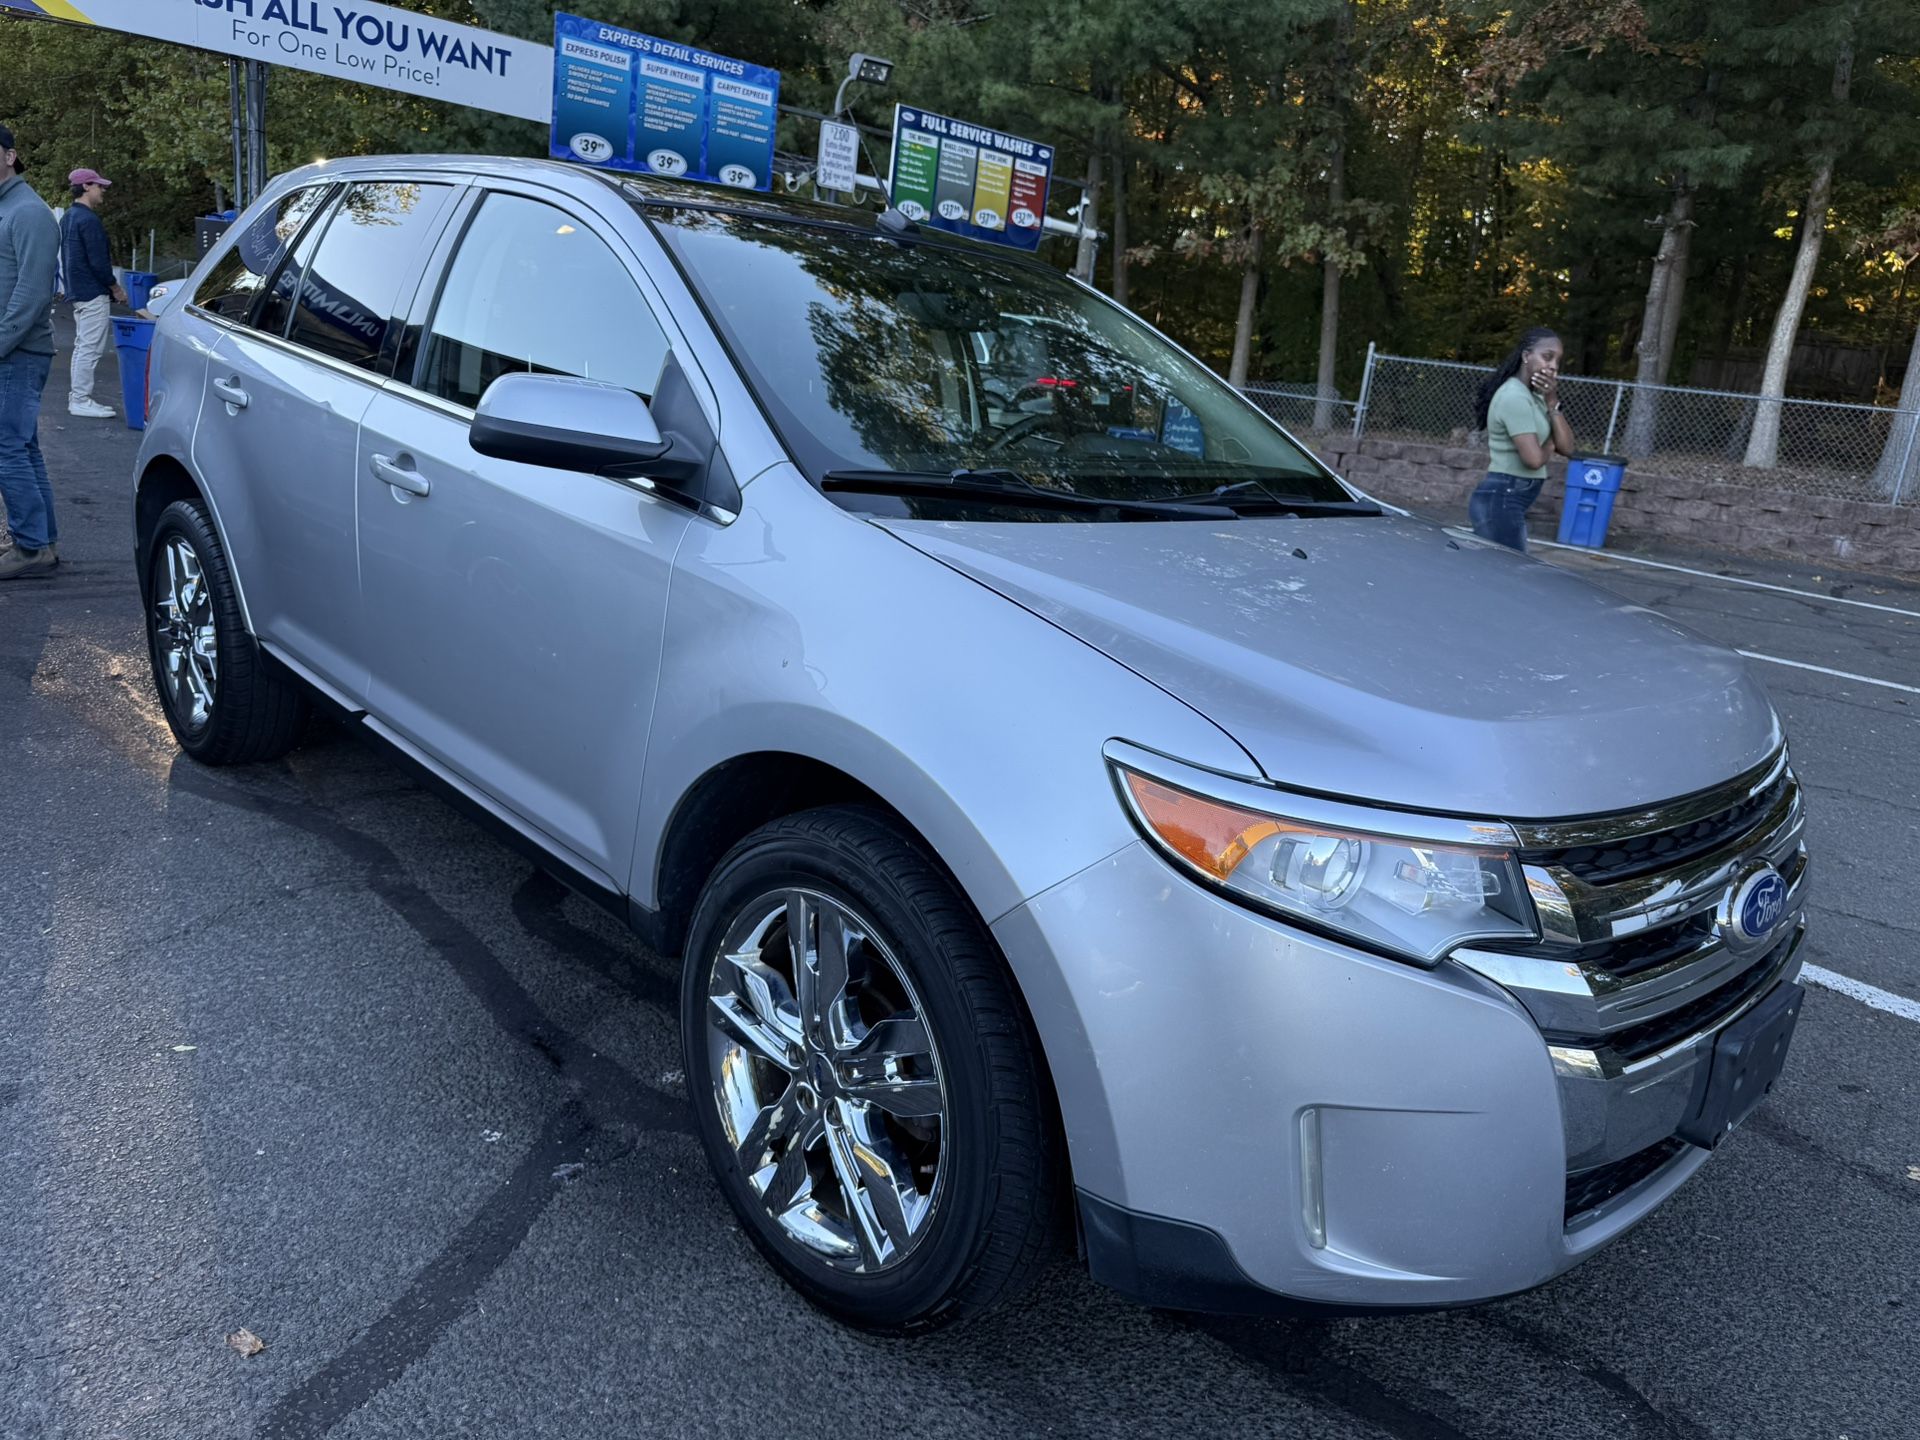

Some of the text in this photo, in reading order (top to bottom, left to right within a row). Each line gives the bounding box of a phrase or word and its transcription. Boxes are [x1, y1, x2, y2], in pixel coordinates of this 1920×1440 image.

[233, 19, 440, 87] For One Low Price!
[262, 0, 512, 77] ALL YOU WANT
[565, 42, 628, 66] EXPRESS POLISH
[599, 27, 745, 76] EXPRESS DETAIL SERVICES
[645, 63, 700, 84] SUPER INTERIOR
[717, 77, 769, 101] CARPET EXPRESS
[920, 114, 948, 134] FULL
[950, 122, 992, 146] SERVICE
[994, 134, 1034, 157] WASHES
[1756, 876, 1783, 928] Ford
